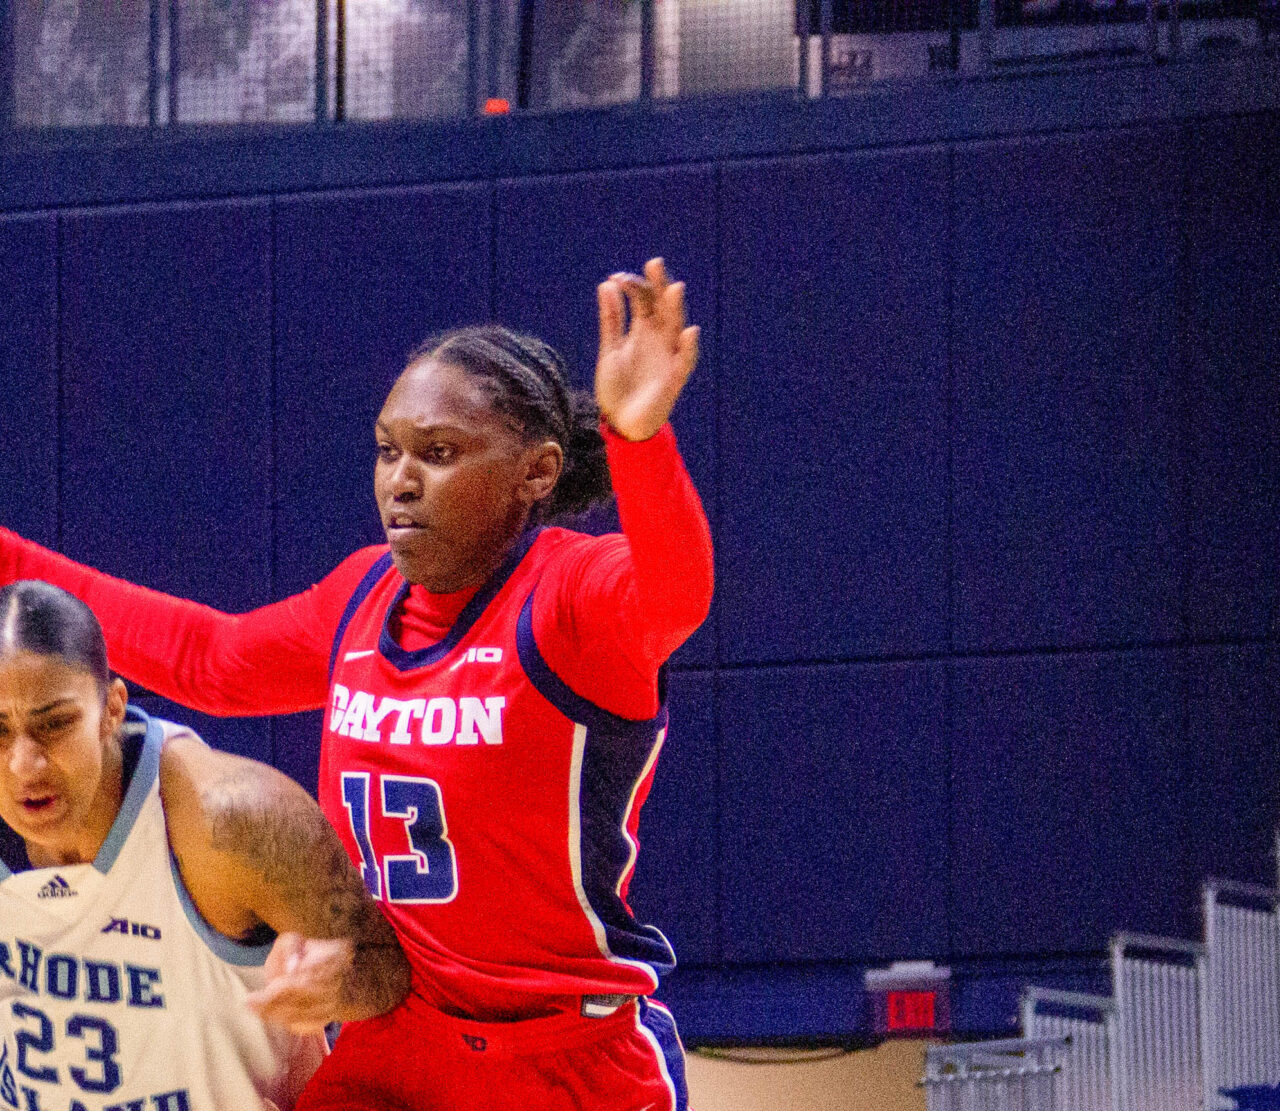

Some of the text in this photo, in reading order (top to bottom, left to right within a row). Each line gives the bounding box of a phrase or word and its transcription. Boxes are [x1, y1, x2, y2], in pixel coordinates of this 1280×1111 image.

[449, 647, 503, 671] 10
[341, 771, 459, 905] 13
[11, 1000, 122, 1095] 23
